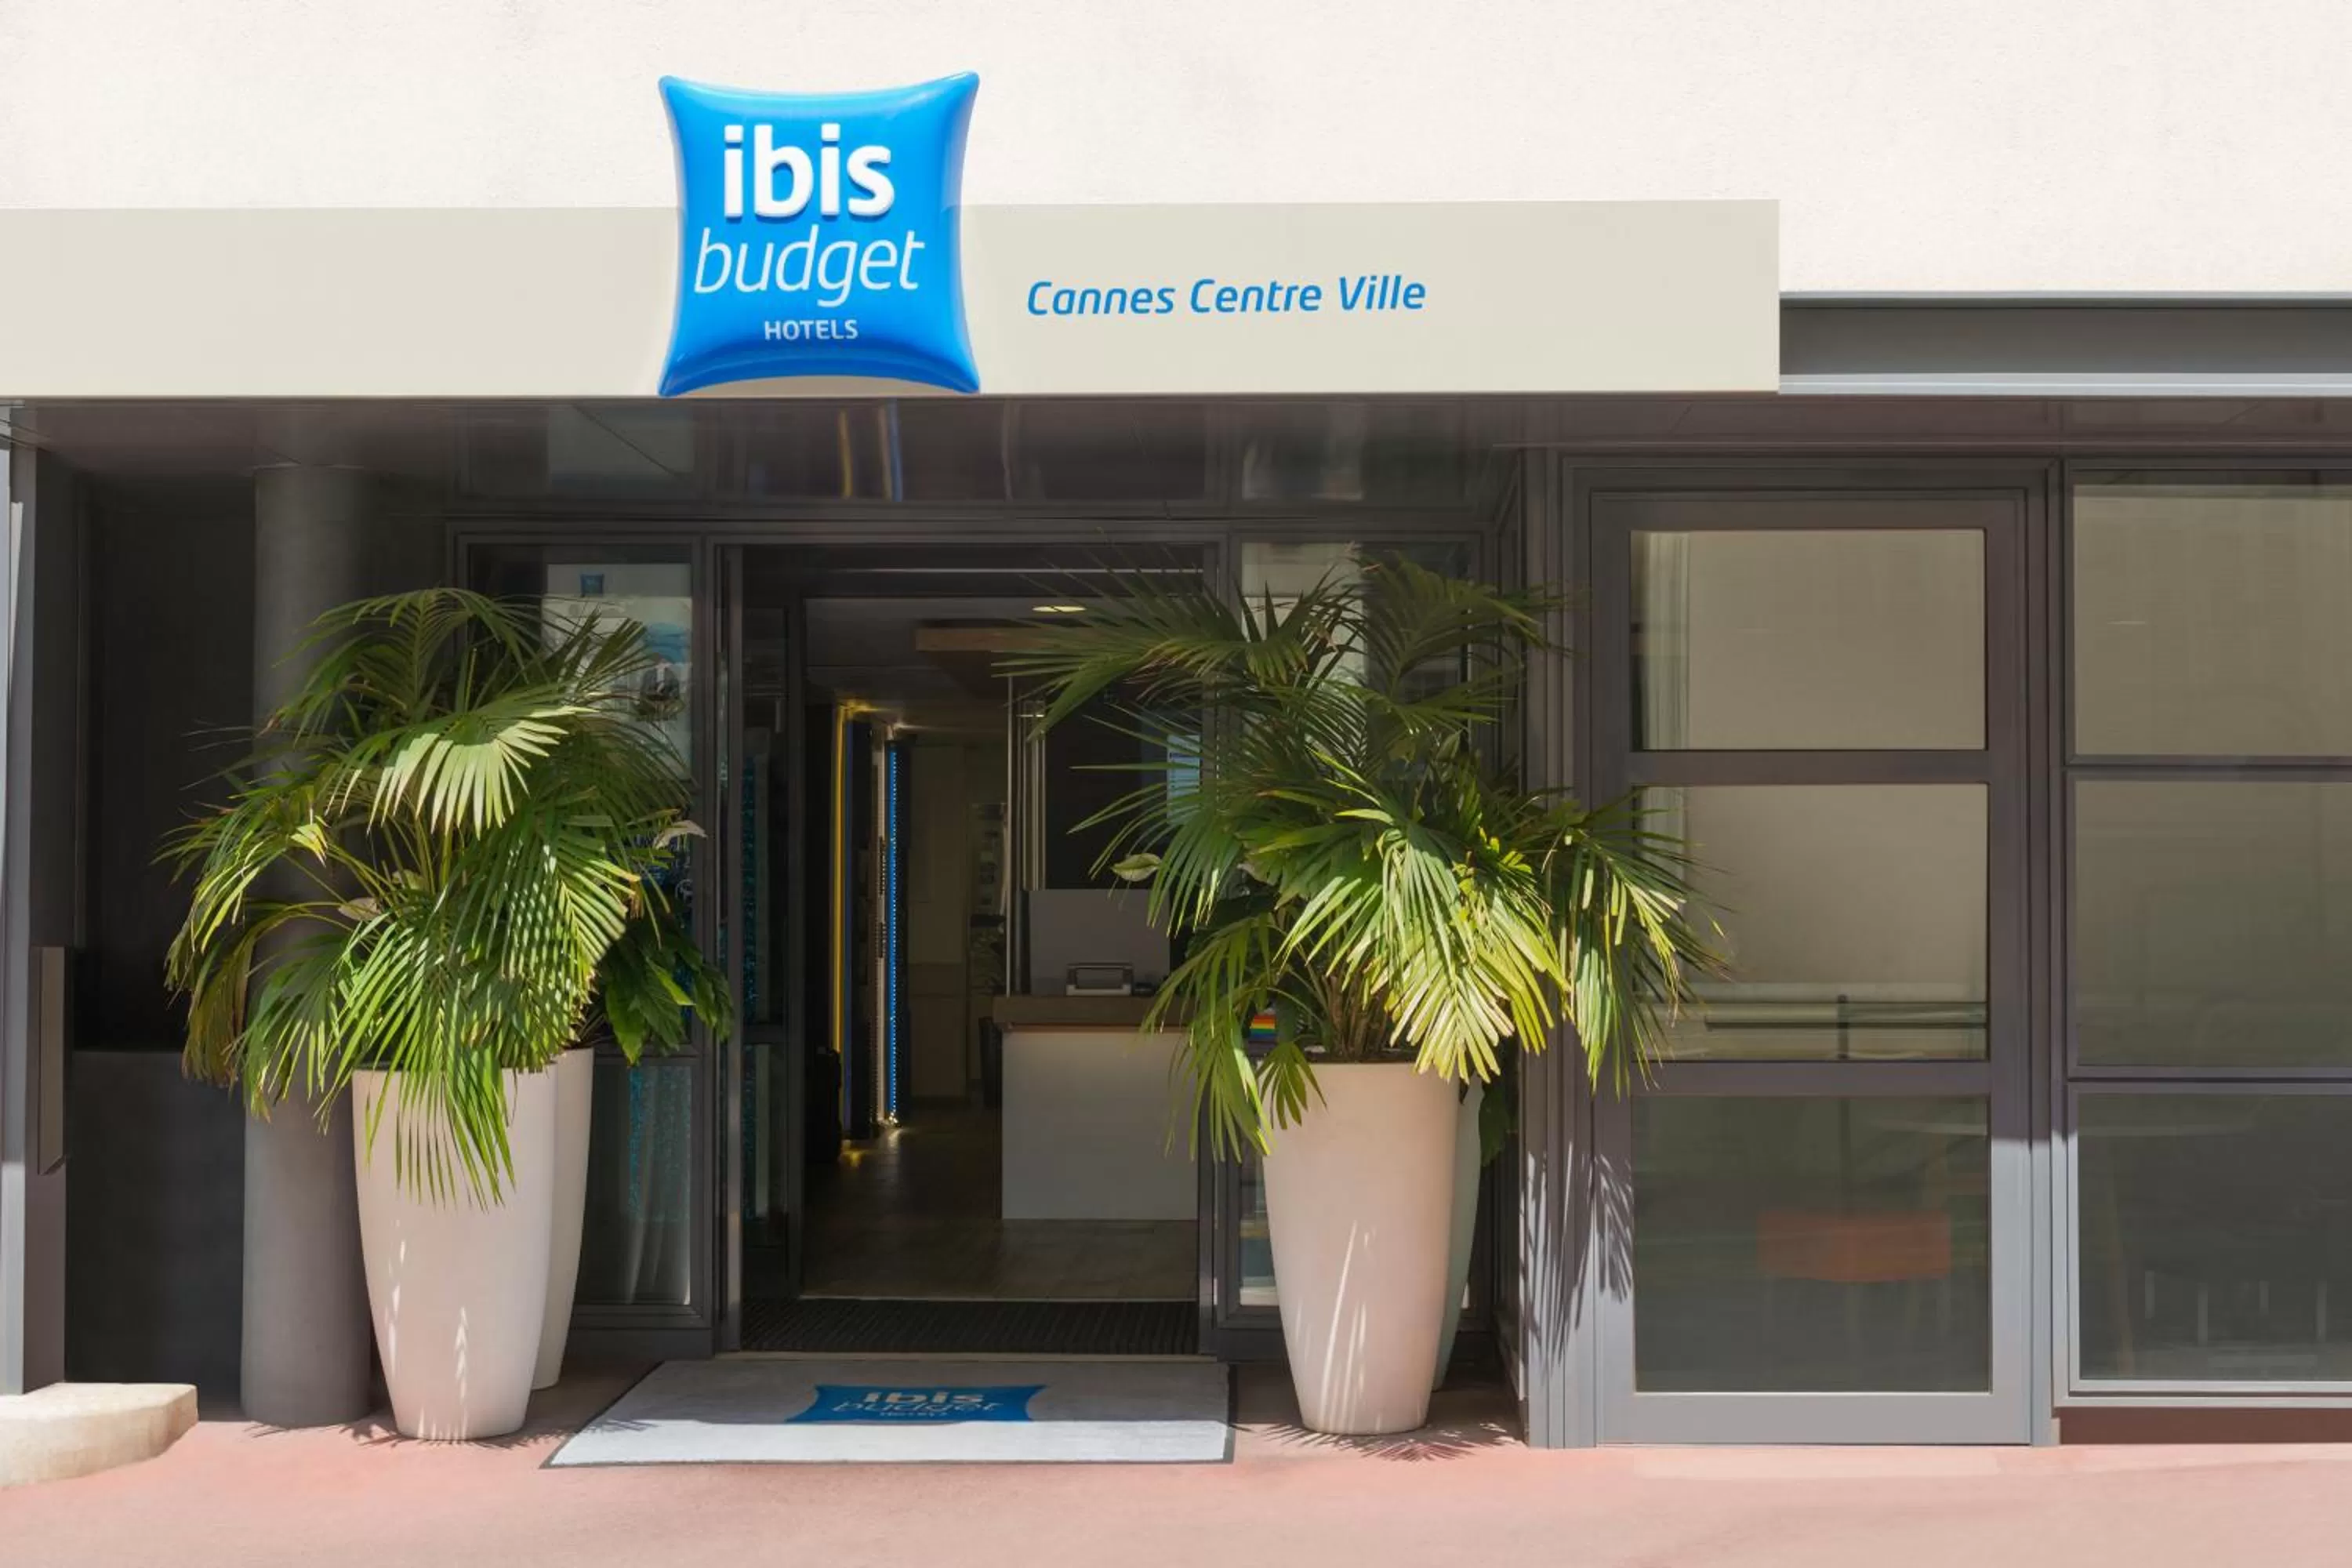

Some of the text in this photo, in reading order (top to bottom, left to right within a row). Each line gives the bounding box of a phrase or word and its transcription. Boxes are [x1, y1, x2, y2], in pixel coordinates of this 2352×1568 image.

[724, 122, 895, 218] ibis
[694, 224, 925, 307] budget
[1026, 274, 1427, 317] Cannes Centre Ville
[764, 319, 858, 340] HOTELS
